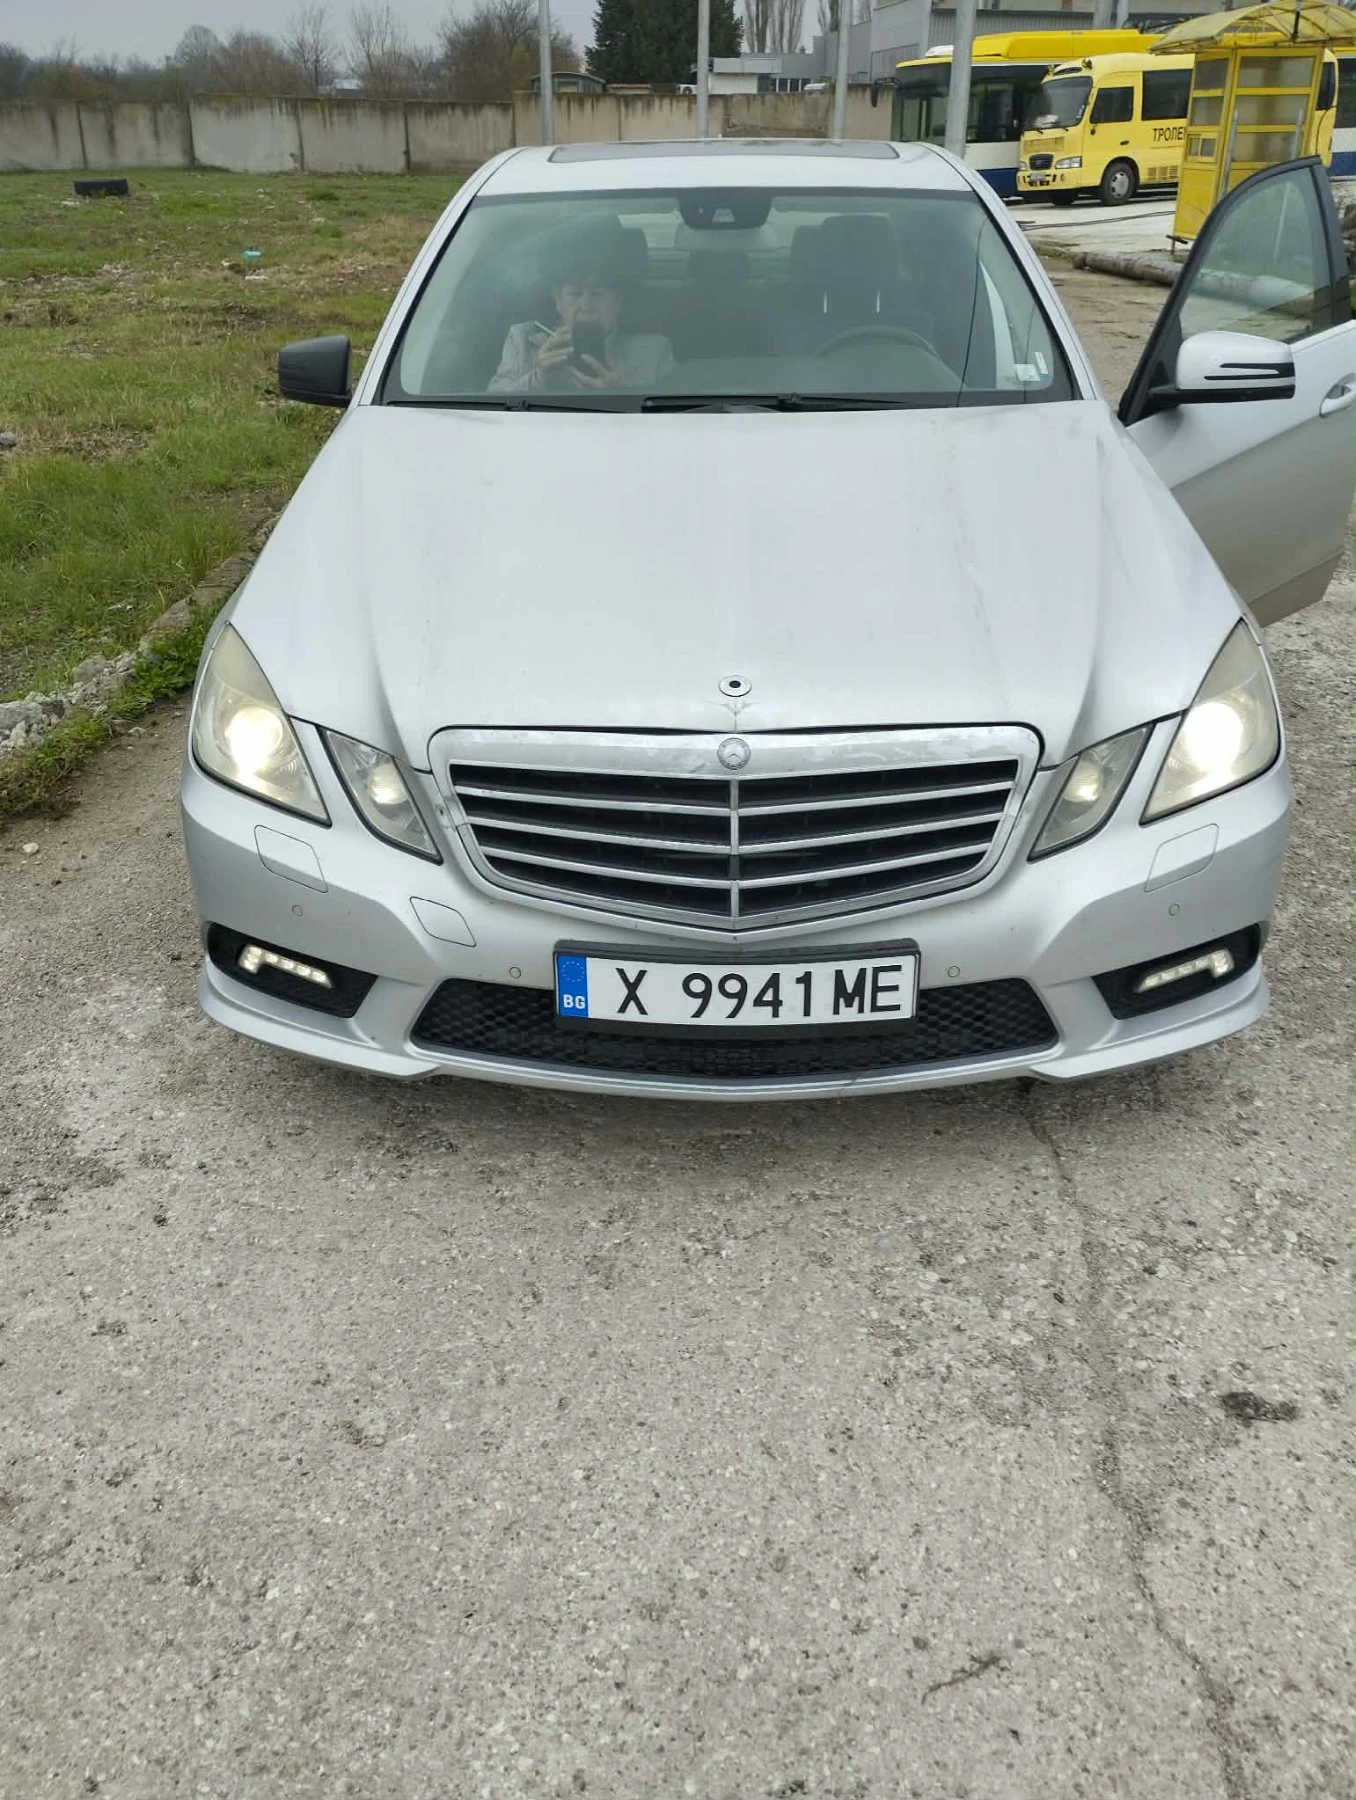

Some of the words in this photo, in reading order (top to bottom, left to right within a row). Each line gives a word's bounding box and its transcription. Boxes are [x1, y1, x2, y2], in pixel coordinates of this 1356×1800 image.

[563, 994, 586, 1009] BG
[615, 967, 649, 1016] X
[682, 970, 814, 1019] 9941
[832, 964, 902, 1015] ME
